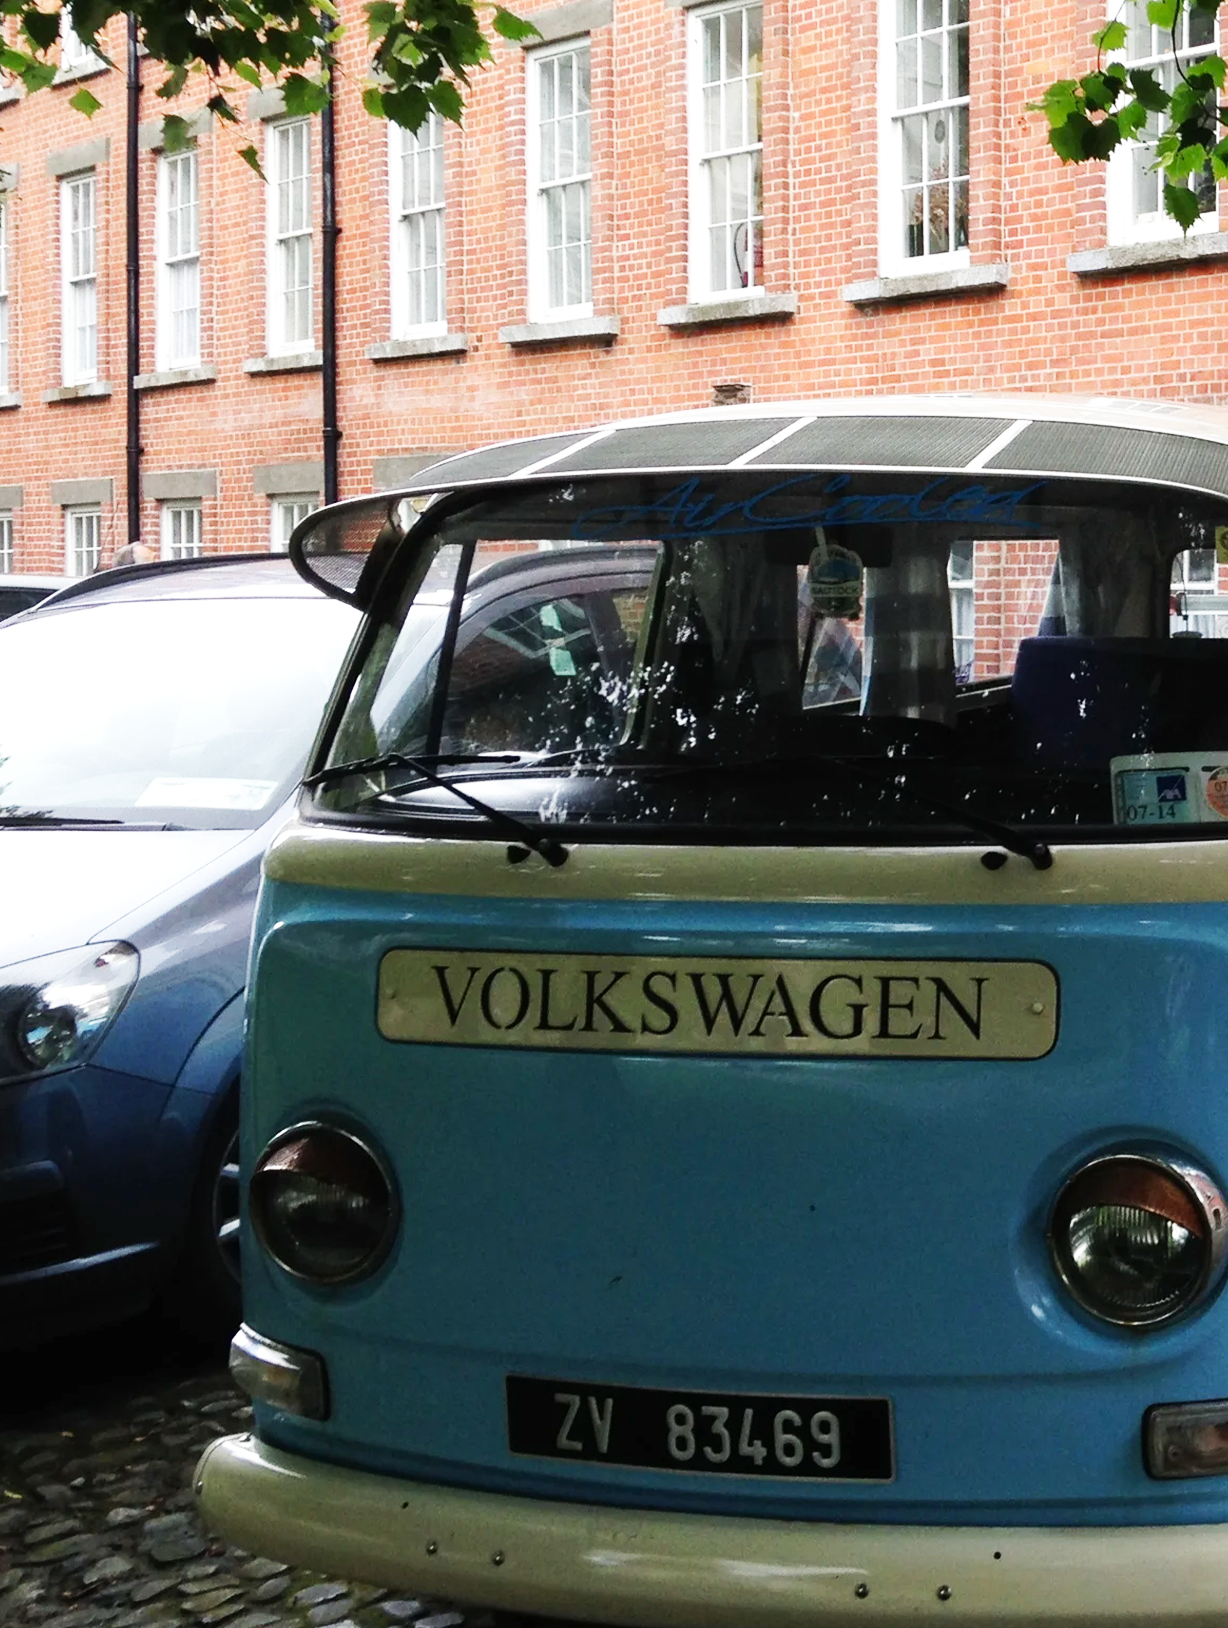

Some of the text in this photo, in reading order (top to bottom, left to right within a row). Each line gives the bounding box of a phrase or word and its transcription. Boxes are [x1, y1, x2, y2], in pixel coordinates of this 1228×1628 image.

[1127, 804, 1176, 821] 07-14
[431, 964, 988, 1041] VOLKSWAGEN
[554, 1393, 842, 1469] ZV 83469
